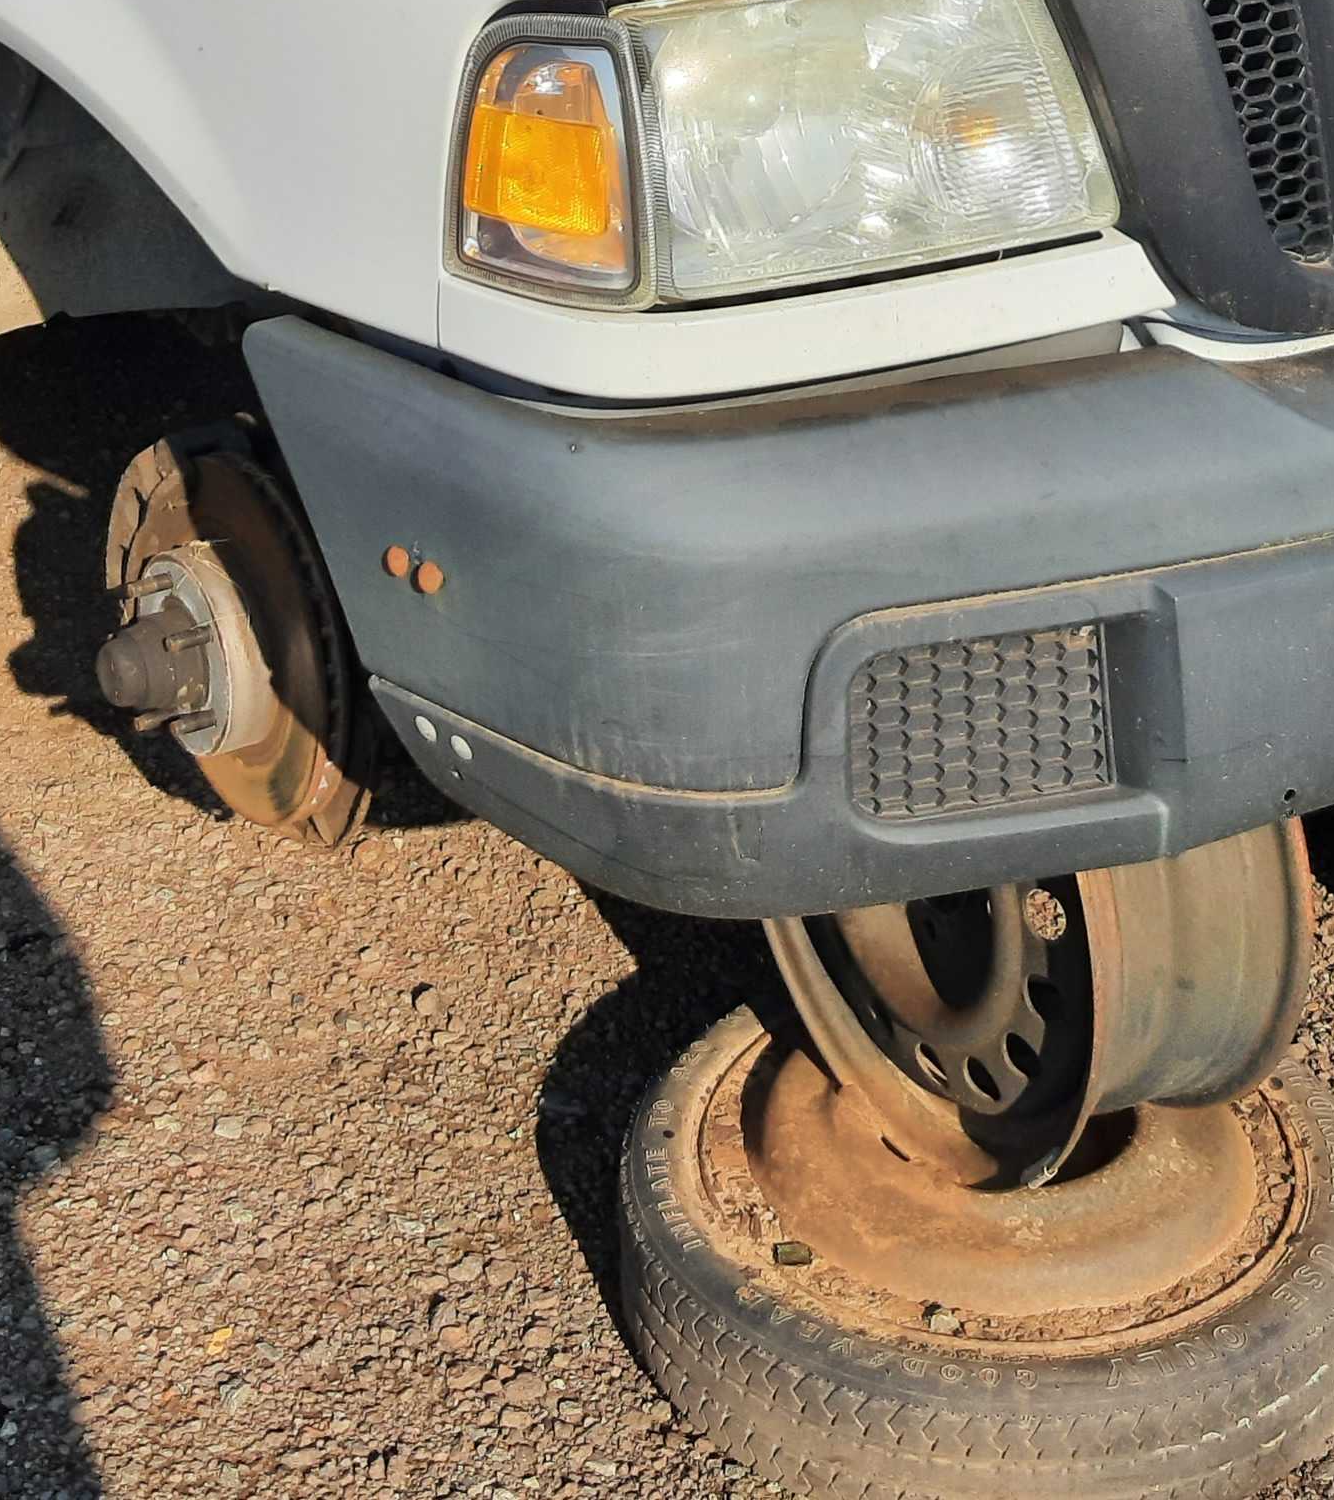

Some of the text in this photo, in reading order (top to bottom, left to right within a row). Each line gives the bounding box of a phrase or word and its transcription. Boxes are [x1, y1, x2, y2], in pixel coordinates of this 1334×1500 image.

[647, 1099, 675, 1129] TO
[646, 1147, 704, 1254] INFLATE
[1105, 1322, 1249, 1390] ONLY
